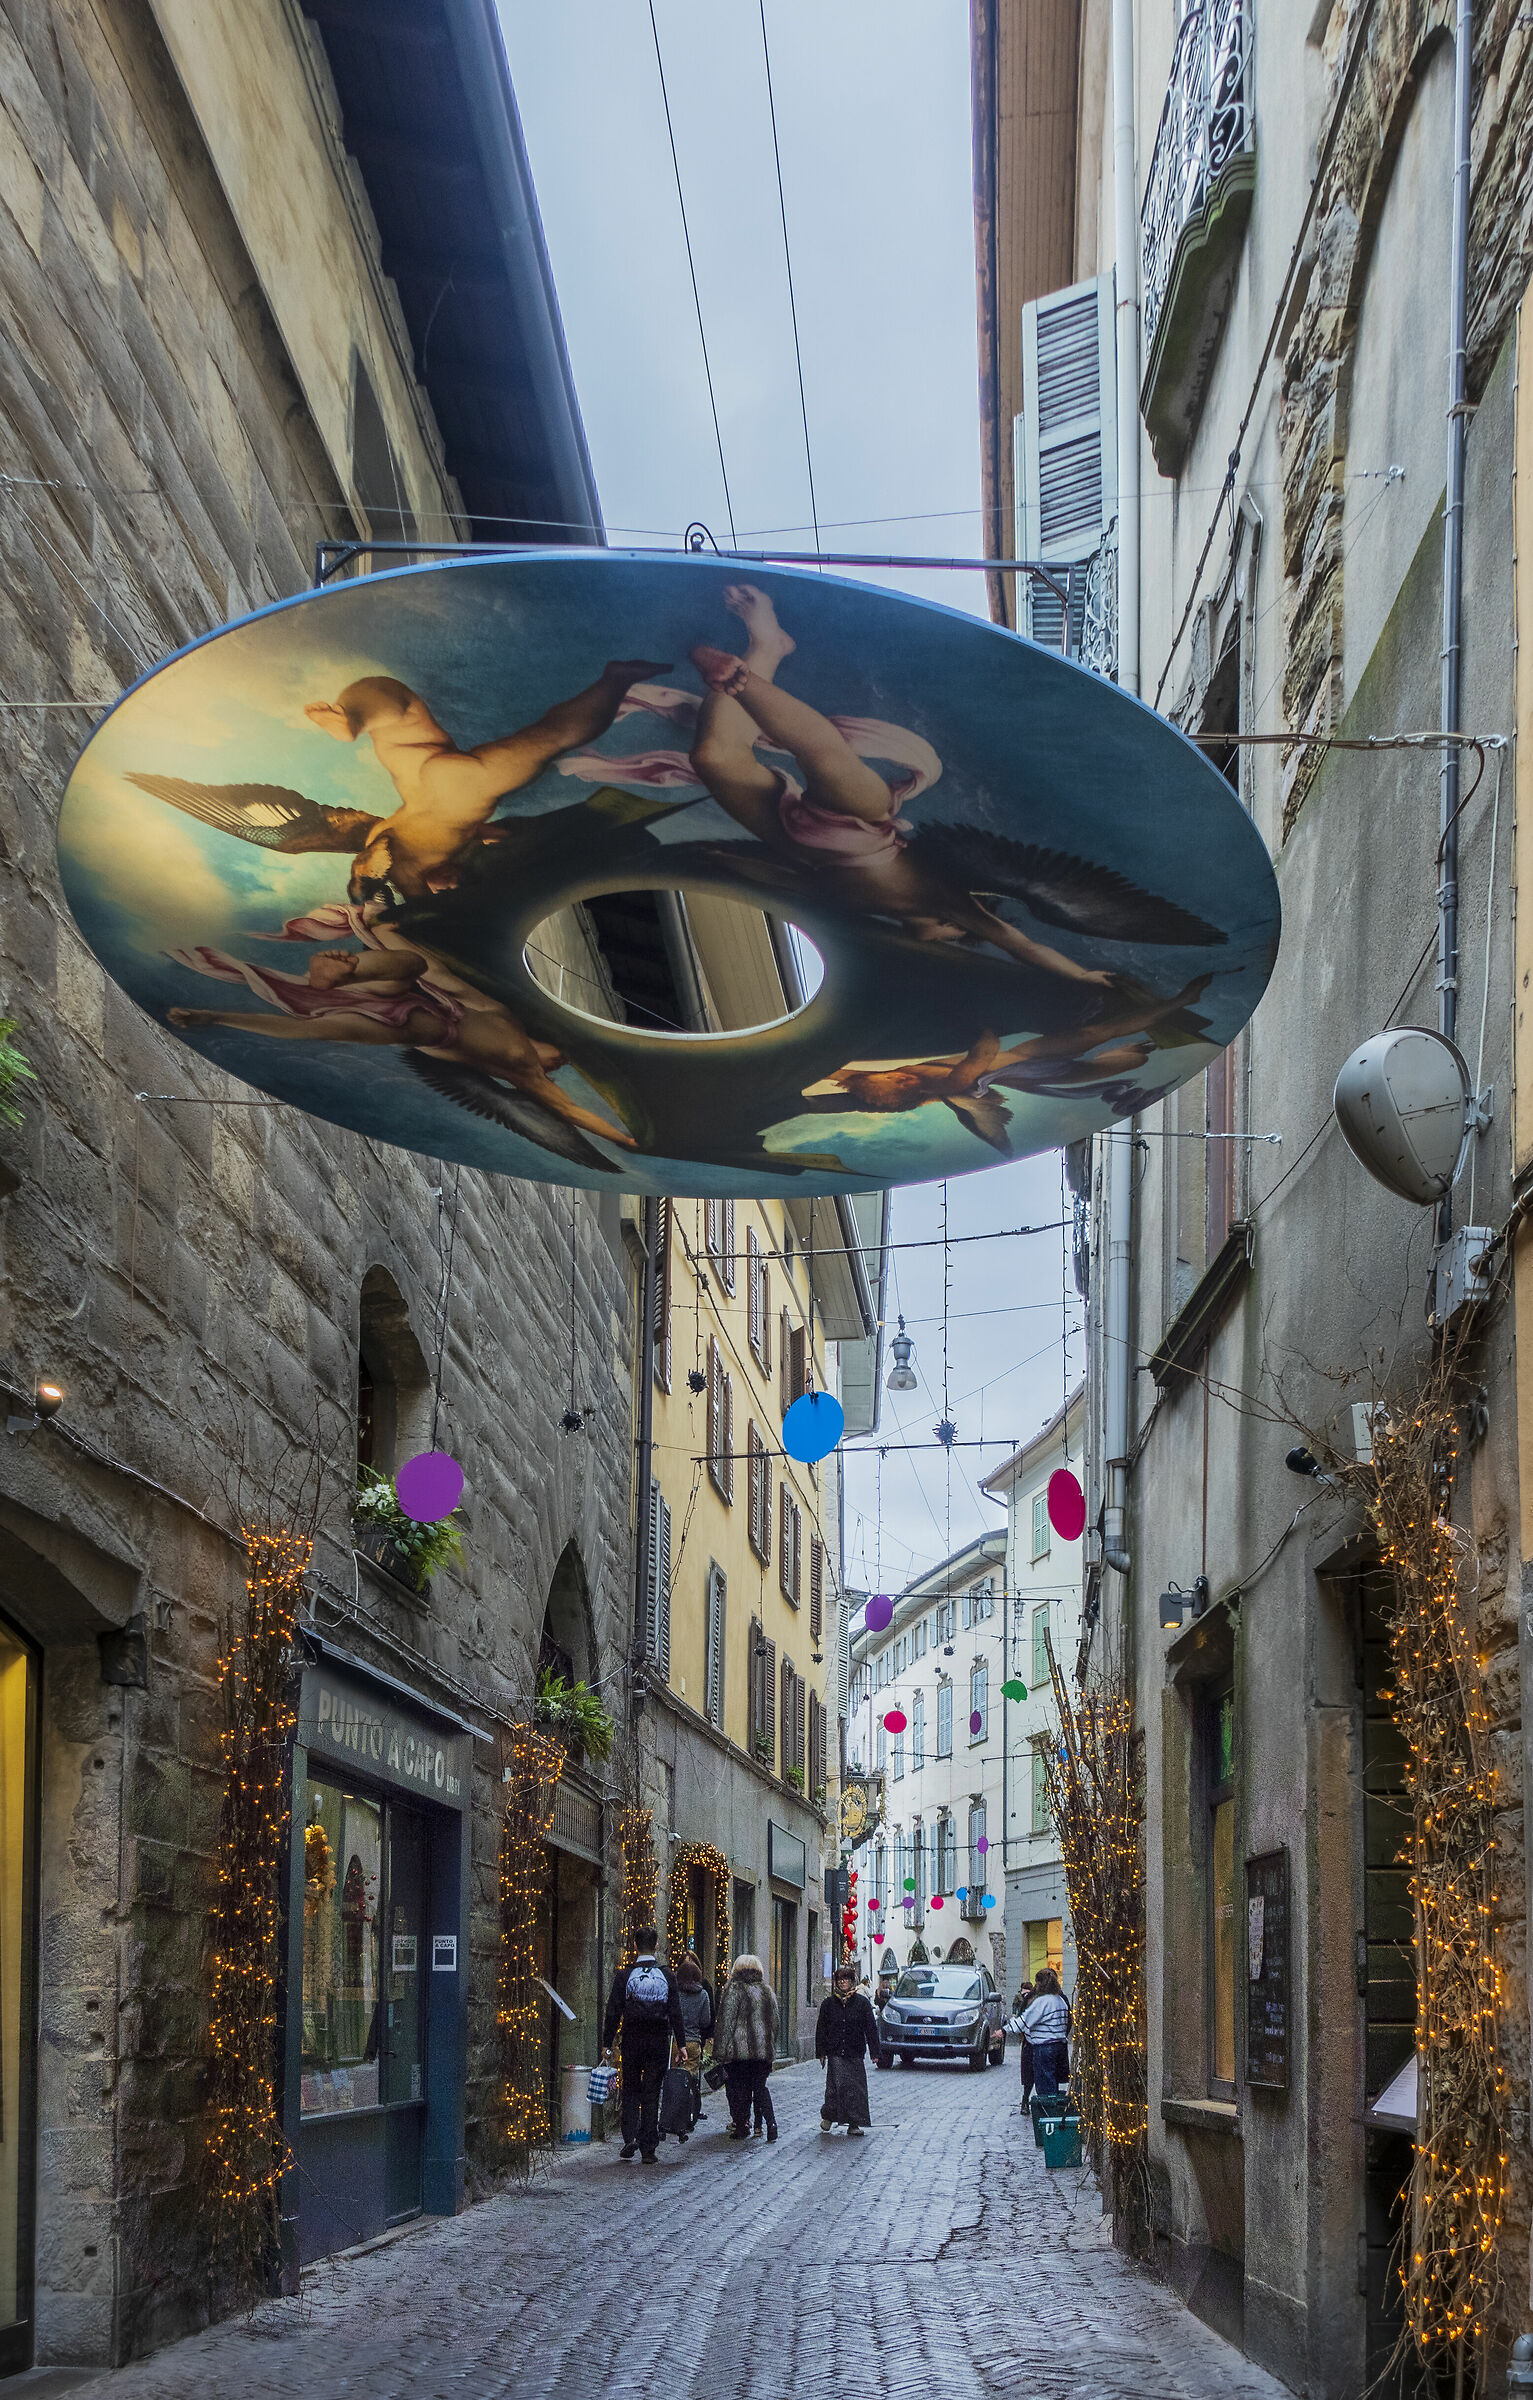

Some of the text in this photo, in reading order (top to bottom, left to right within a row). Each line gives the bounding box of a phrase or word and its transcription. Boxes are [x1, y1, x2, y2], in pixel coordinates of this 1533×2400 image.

[317, 1688, 445, 1788] PUNTO A CAPO
